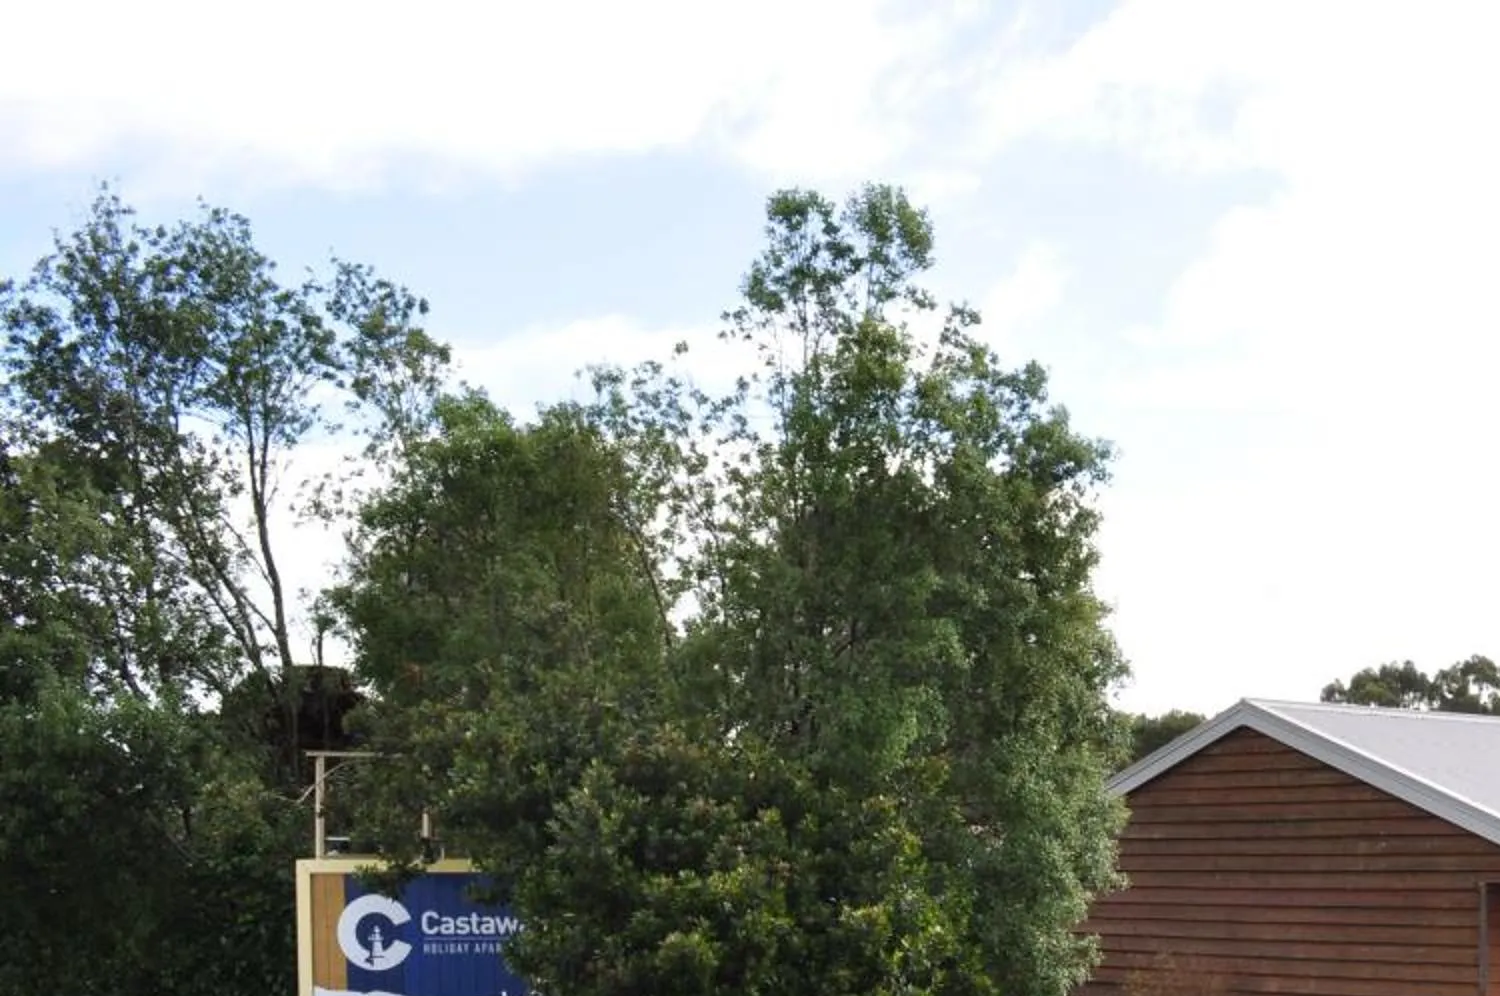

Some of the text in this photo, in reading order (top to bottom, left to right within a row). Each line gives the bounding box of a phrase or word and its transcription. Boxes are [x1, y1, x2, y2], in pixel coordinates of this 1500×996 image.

[421, 910, 523, 935] Castaw
[423, 943, 503, 954] HOLIDAY APAR
